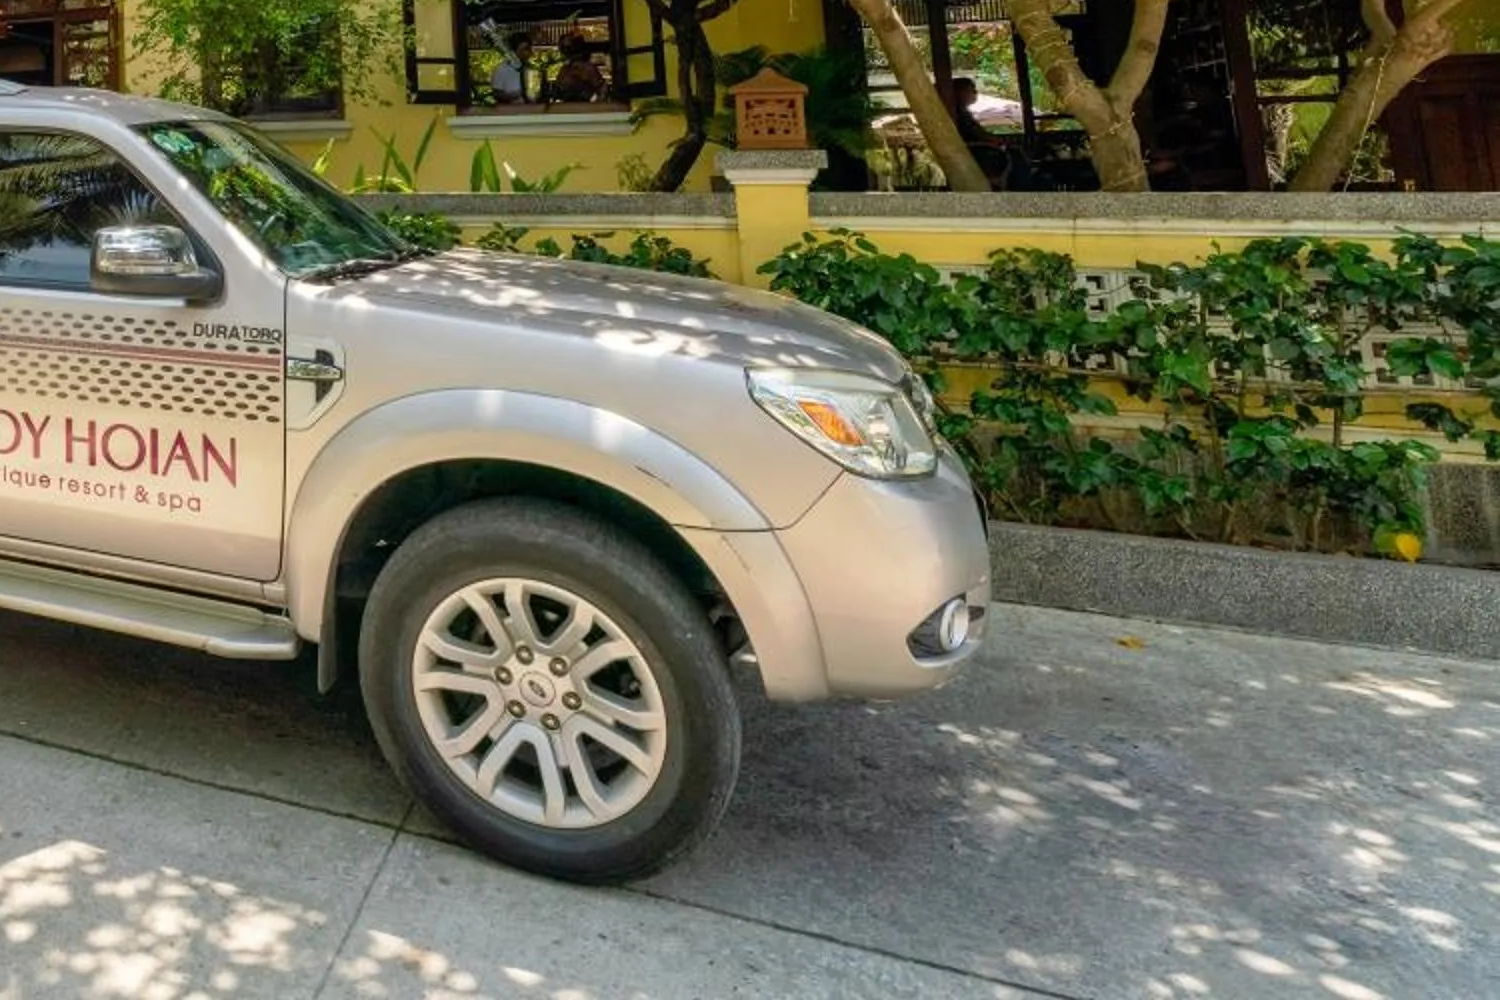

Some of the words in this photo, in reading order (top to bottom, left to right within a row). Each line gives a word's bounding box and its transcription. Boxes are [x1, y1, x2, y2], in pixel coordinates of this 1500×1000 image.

[193, 323, 282, 344] DURATORQ
[65, 418, 237, 488] HOIAN
[59, 476, 126, 500] resort
[133, 484, 149, 504] &
[157, 491, 201, 512] spa
